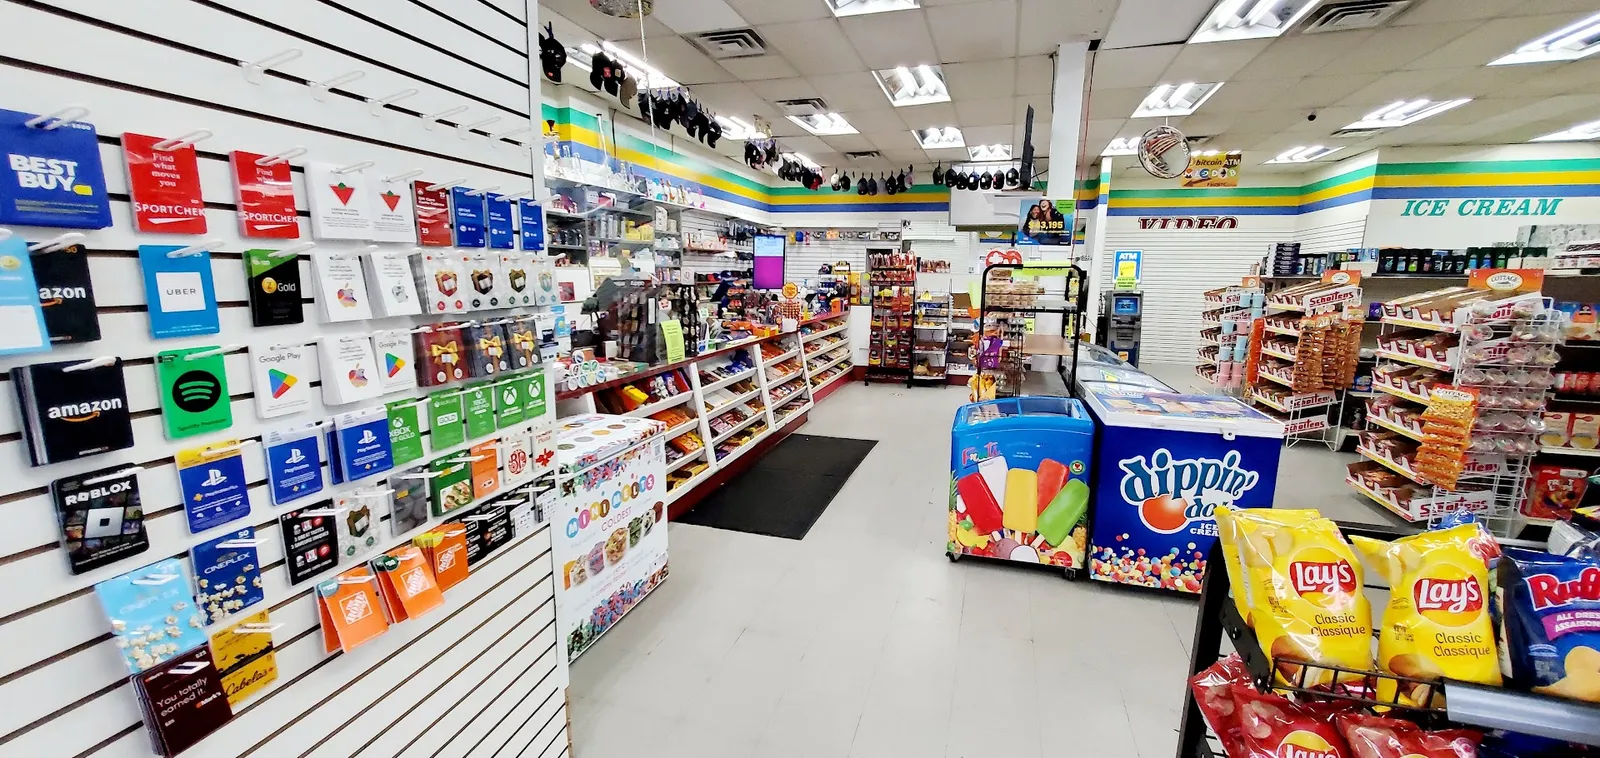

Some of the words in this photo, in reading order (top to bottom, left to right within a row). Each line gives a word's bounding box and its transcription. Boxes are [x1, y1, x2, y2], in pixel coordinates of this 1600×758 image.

[8, 153, 78, 173] BEST
[153, 152, 174, 162] Find
[152, 161, 176, 171] what
[256, 168, 273, 176] Find
[19, 171, 76, 192] BUY
[151, 171, 181, 180] moves
[159, 179, 177, 188] you
[135, 202, 206, 217] SPORTCHEK
[1400, 199, 1450, 217] ICE
[1458, 198, 1564, 216] CREAM
[243, 211, 299, 223] SPORTCHEK
[1138, 216, 1239, 229] VIDEO
[1491, 275, 1518, 283] COTTAGE
[39, 286, 87, 299] azon
[166, 288, 197, 296] UBER
[277, 283, 296, 292] Gold
[1309, 290, 1355, 306] Scholtens
[378, 341, 397, 349] Google
[259, 353, 286, 364] Google
[287, 353, 302, 361] Play
[1436, 389, 1470, 399] COTTAGE
[48, 397, 123, 419] amazon
[439, 414, 457, 424] GOLD
[389, 426, 411, 438] XBOX
[1121, 450, 1258, 502] dippin'
[65, 480, 132, 506] ROBLOX
[566, 499, 610, 539] MINI
[612, 474, 655, 509] MELTS
[601, 506, 632, 531] COLDEST
[238, 529, 249, 538] 50
[1189, 528, 1220, 537] CREA
[204, 551, 251, 574] CINEPLEX
[1295, 560, 1352, 595] Lay's
[1418, 577, 1480, 613] Lay's
[1314, 614, 1356, 625] Classic
[1557, 613, 1574, 621] ALL
[1310, 625, 1366, 638] Classique
[1435, 632, 1483, 644] Classic
[1433, 645, 1491, 659] Classique
[156, 693, 178, 708] You
[179, 677, 207, 696] totally
[160, 692, 196, 717] earned
